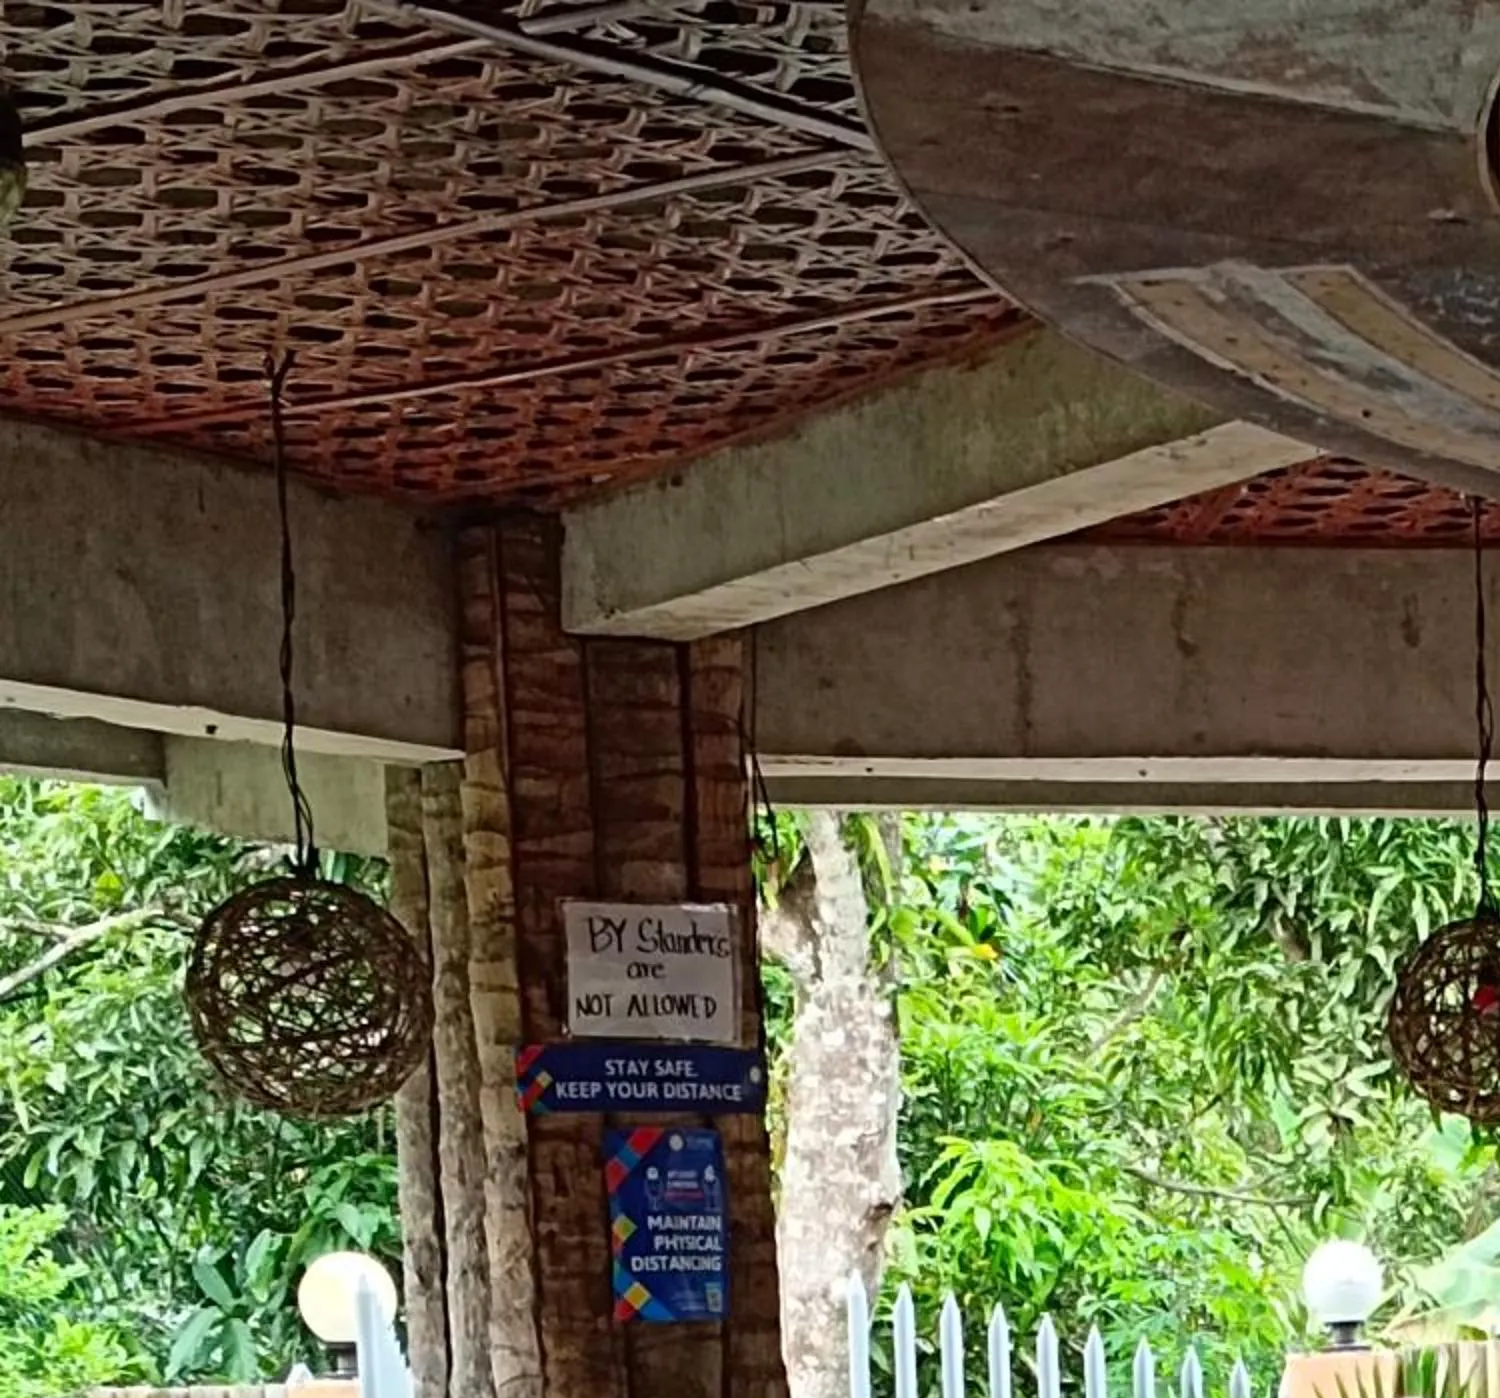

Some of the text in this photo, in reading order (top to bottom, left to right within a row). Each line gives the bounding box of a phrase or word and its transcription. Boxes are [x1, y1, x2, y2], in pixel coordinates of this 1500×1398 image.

[588, 916, 628, 953] BY
[626, 961, 667, 980] are
[575, 993, 718, 1020] NOT ALLOWED
[604, 1059, 649, 1077] STAY
[555, 1081, 742, 1101] KEEP YOUR DISTANCE
[647, 1215, 722, 1231] MAINTAIN
[653, 1234, 723, 1251] PHYSICAL
[630, 1255, 722, 1272] DISTANCING
